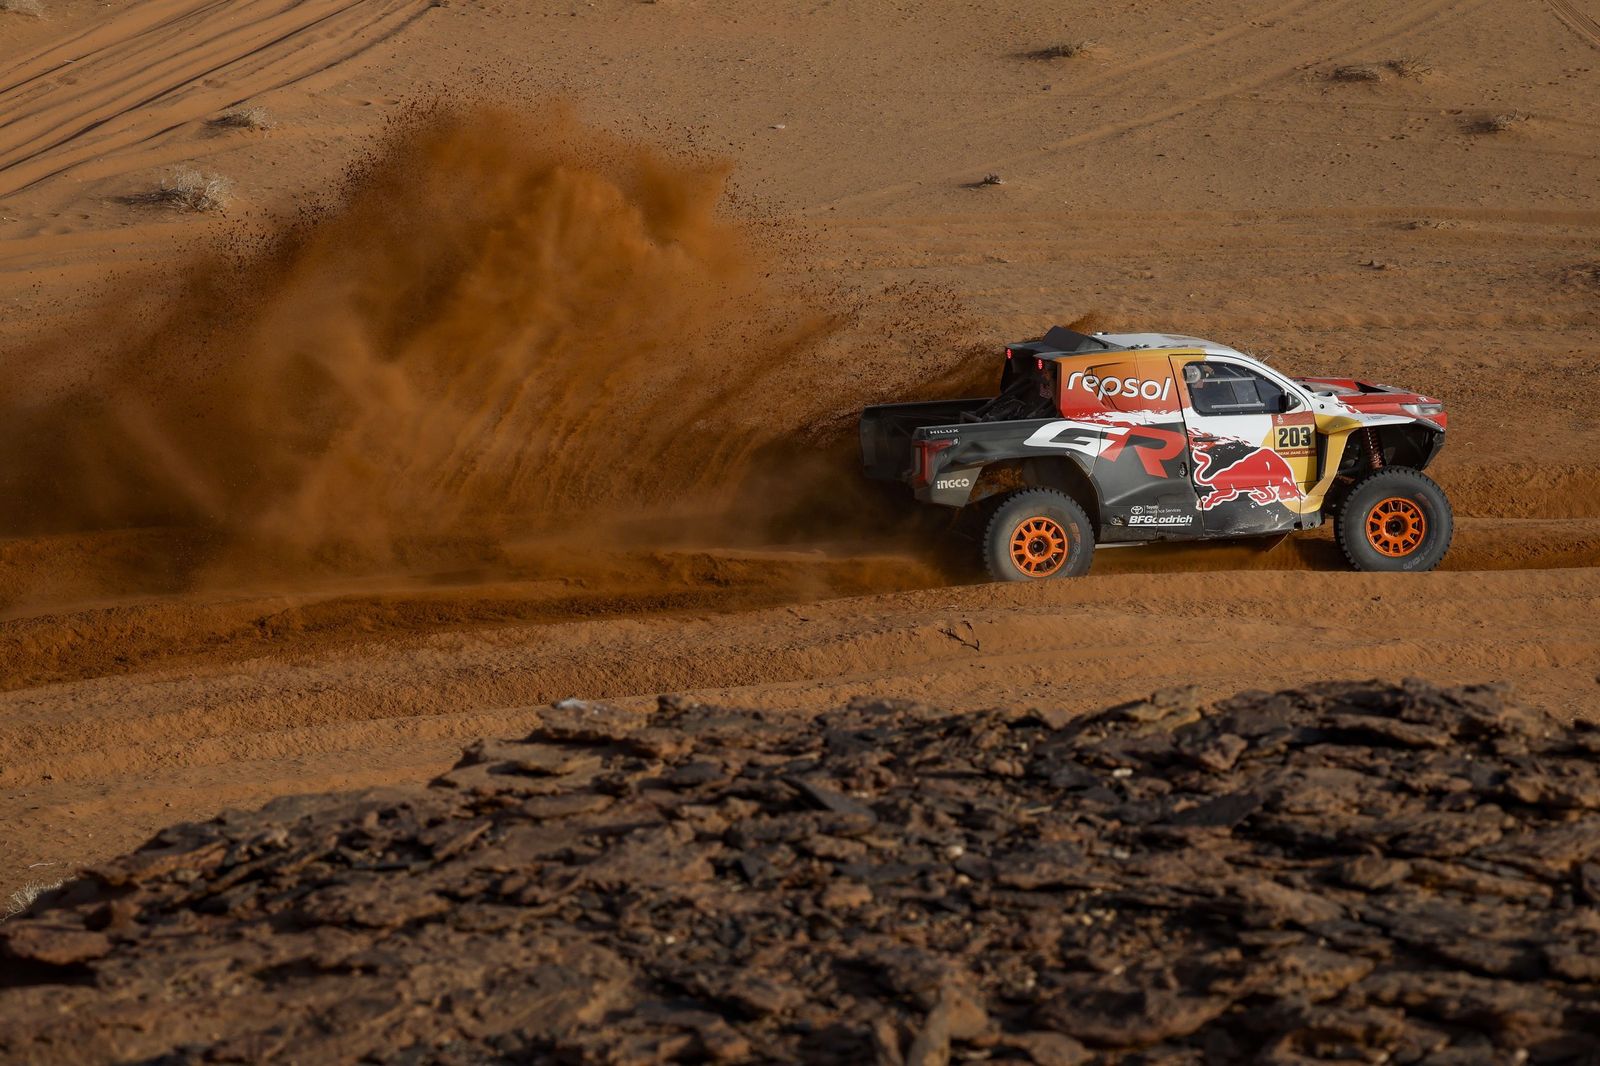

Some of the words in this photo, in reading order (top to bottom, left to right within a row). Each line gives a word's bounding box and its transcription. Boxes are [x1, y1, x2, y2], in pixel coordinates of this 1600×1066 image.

[1067, 371, 1171, 401] repsol
[1023, 420, 1187, 479] GR
[1278, 427, 1311, 447] 203
[1129, 515, 1193, 524] BFGoodrich
